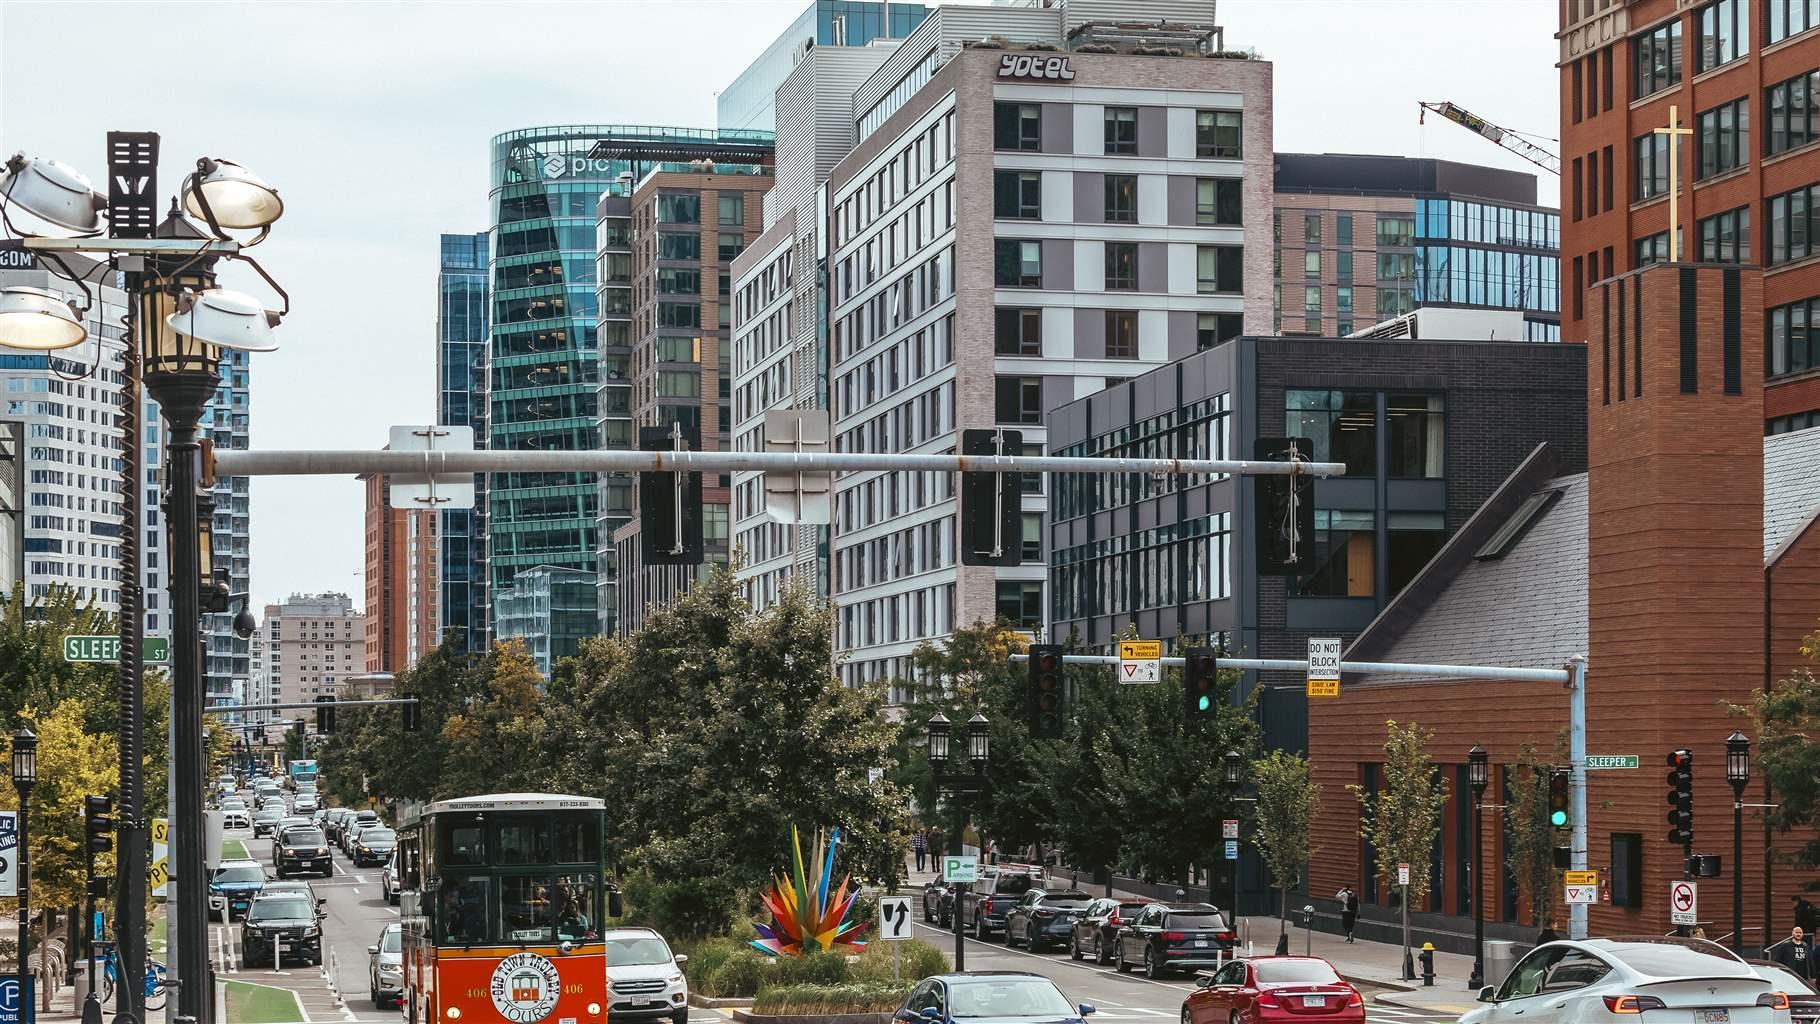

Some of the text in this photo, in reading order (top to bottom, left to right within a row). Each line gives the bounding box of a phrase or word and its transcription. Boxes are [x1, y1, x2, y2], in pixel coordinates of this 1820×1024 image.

[69, 639, 166, 659] SLEEP ST
[1310, 644, 1339, 653] DO NOT
[1311, 657, 1337, 666] BLOCK
[1589, 757, 1626, 767] SLEEPER
[491, 954, 560, 996] OLD TOWN TROLLEY
[466, 987, 487, 998] 406
[564, 984, 583, 994] 406
[501, 1000, 553, 1023] TOURS
